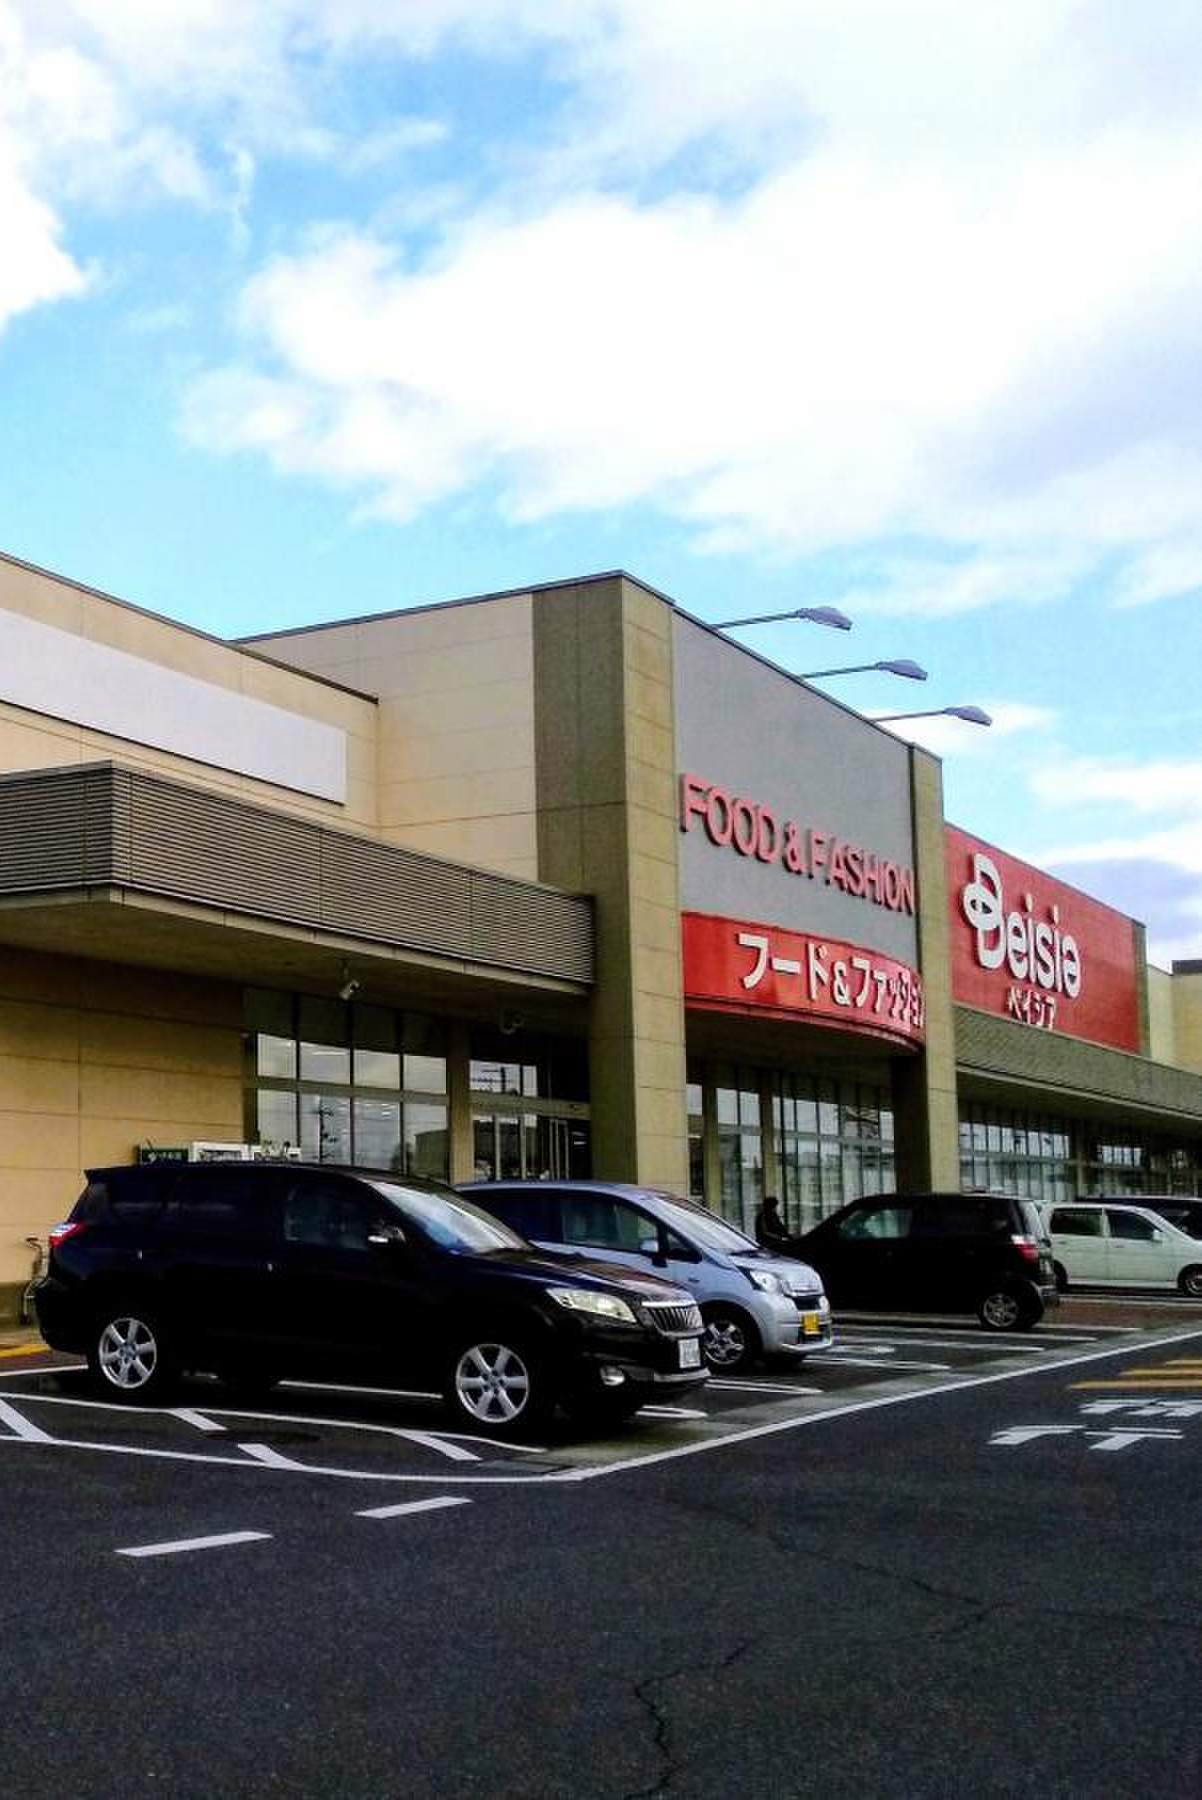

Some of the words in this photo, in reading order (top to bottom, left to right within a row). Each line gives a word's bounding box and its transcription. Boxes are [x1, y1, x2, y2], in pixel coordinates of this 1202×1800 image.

[679, 773, 781, 864] FOOD
[783, 818, 809, 876] &
[808, 830, 916, 916] FASHION
[962, 852, 1082, 999] Beisia
[1006, 985, 1056, 1031] ベイシア
